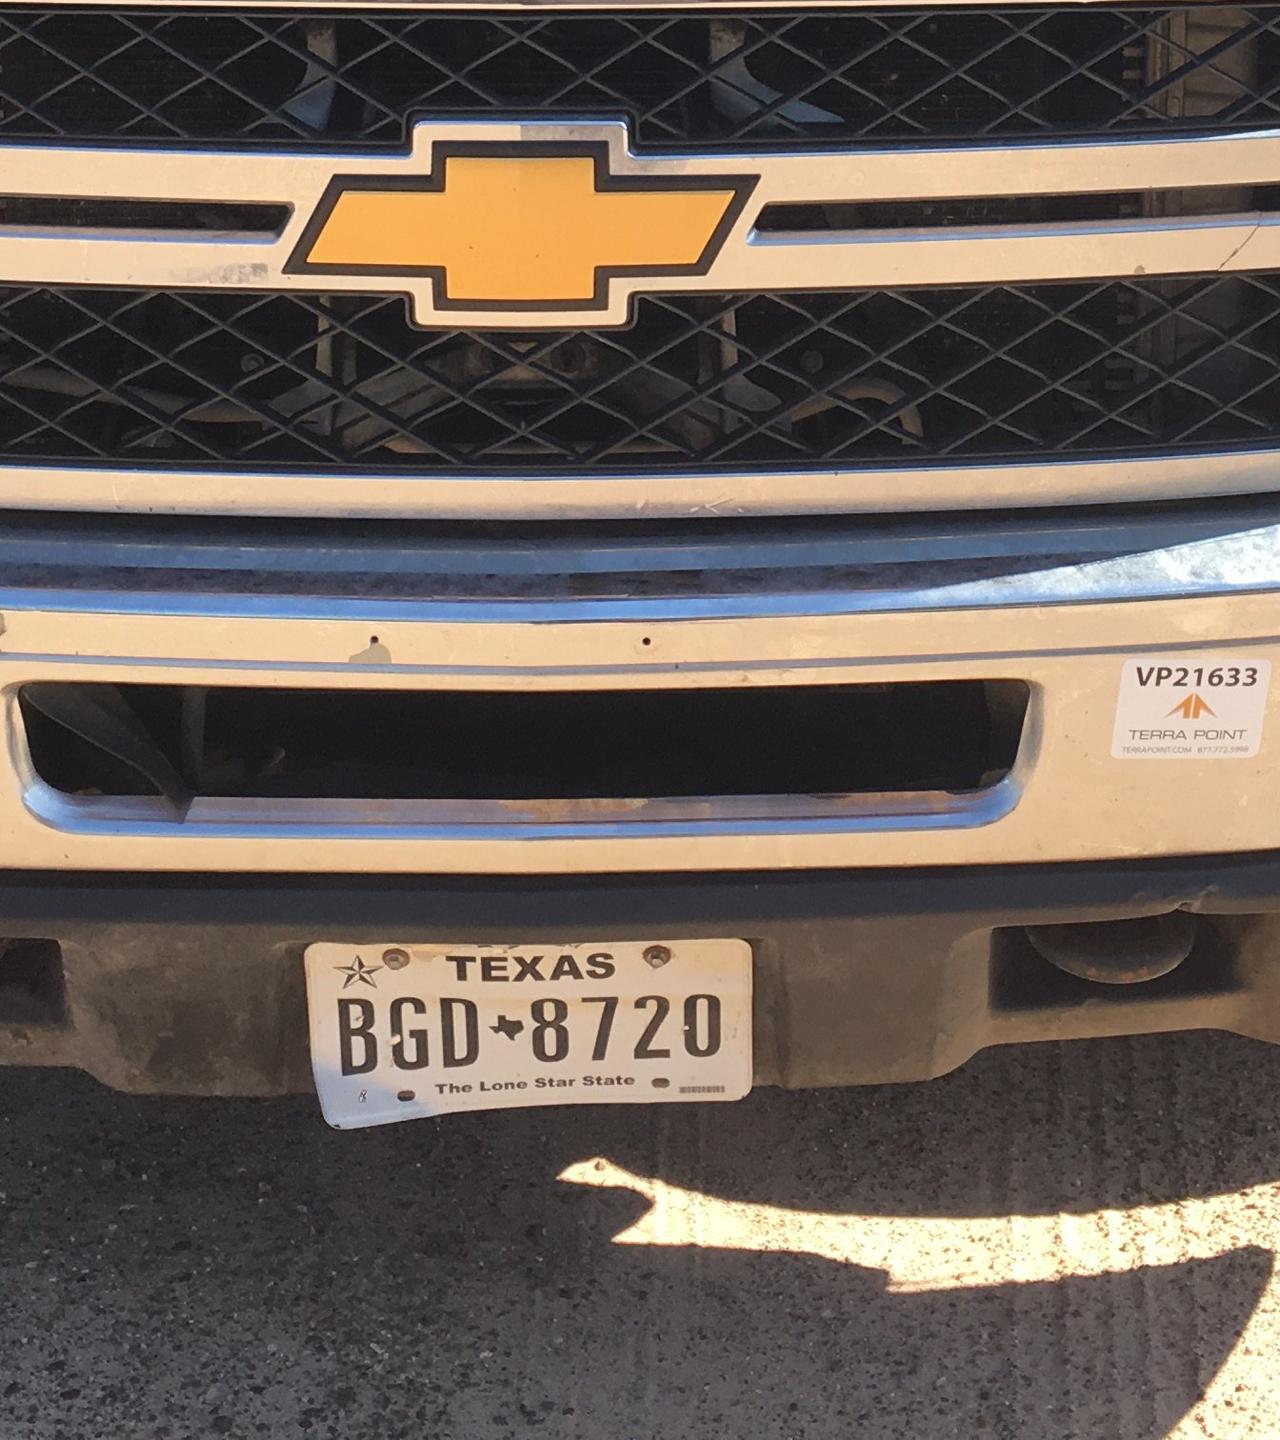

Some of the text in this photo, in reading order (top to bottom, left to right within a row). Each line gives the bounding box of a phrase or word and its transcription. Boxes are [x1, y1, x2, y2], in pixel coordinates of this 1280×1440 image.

[1135, 666, 1258, 688] VP21633
[1128, 729, 1248, 741] TERRA POINT
[1121, 745, 1193, 754] TERRAPOINT.COM
[445, 952, 617, 983] TEXAS
[336, 992, 723, 1078] BGD 8720
[434, 1074, 636, 1095] The Lone Star State
